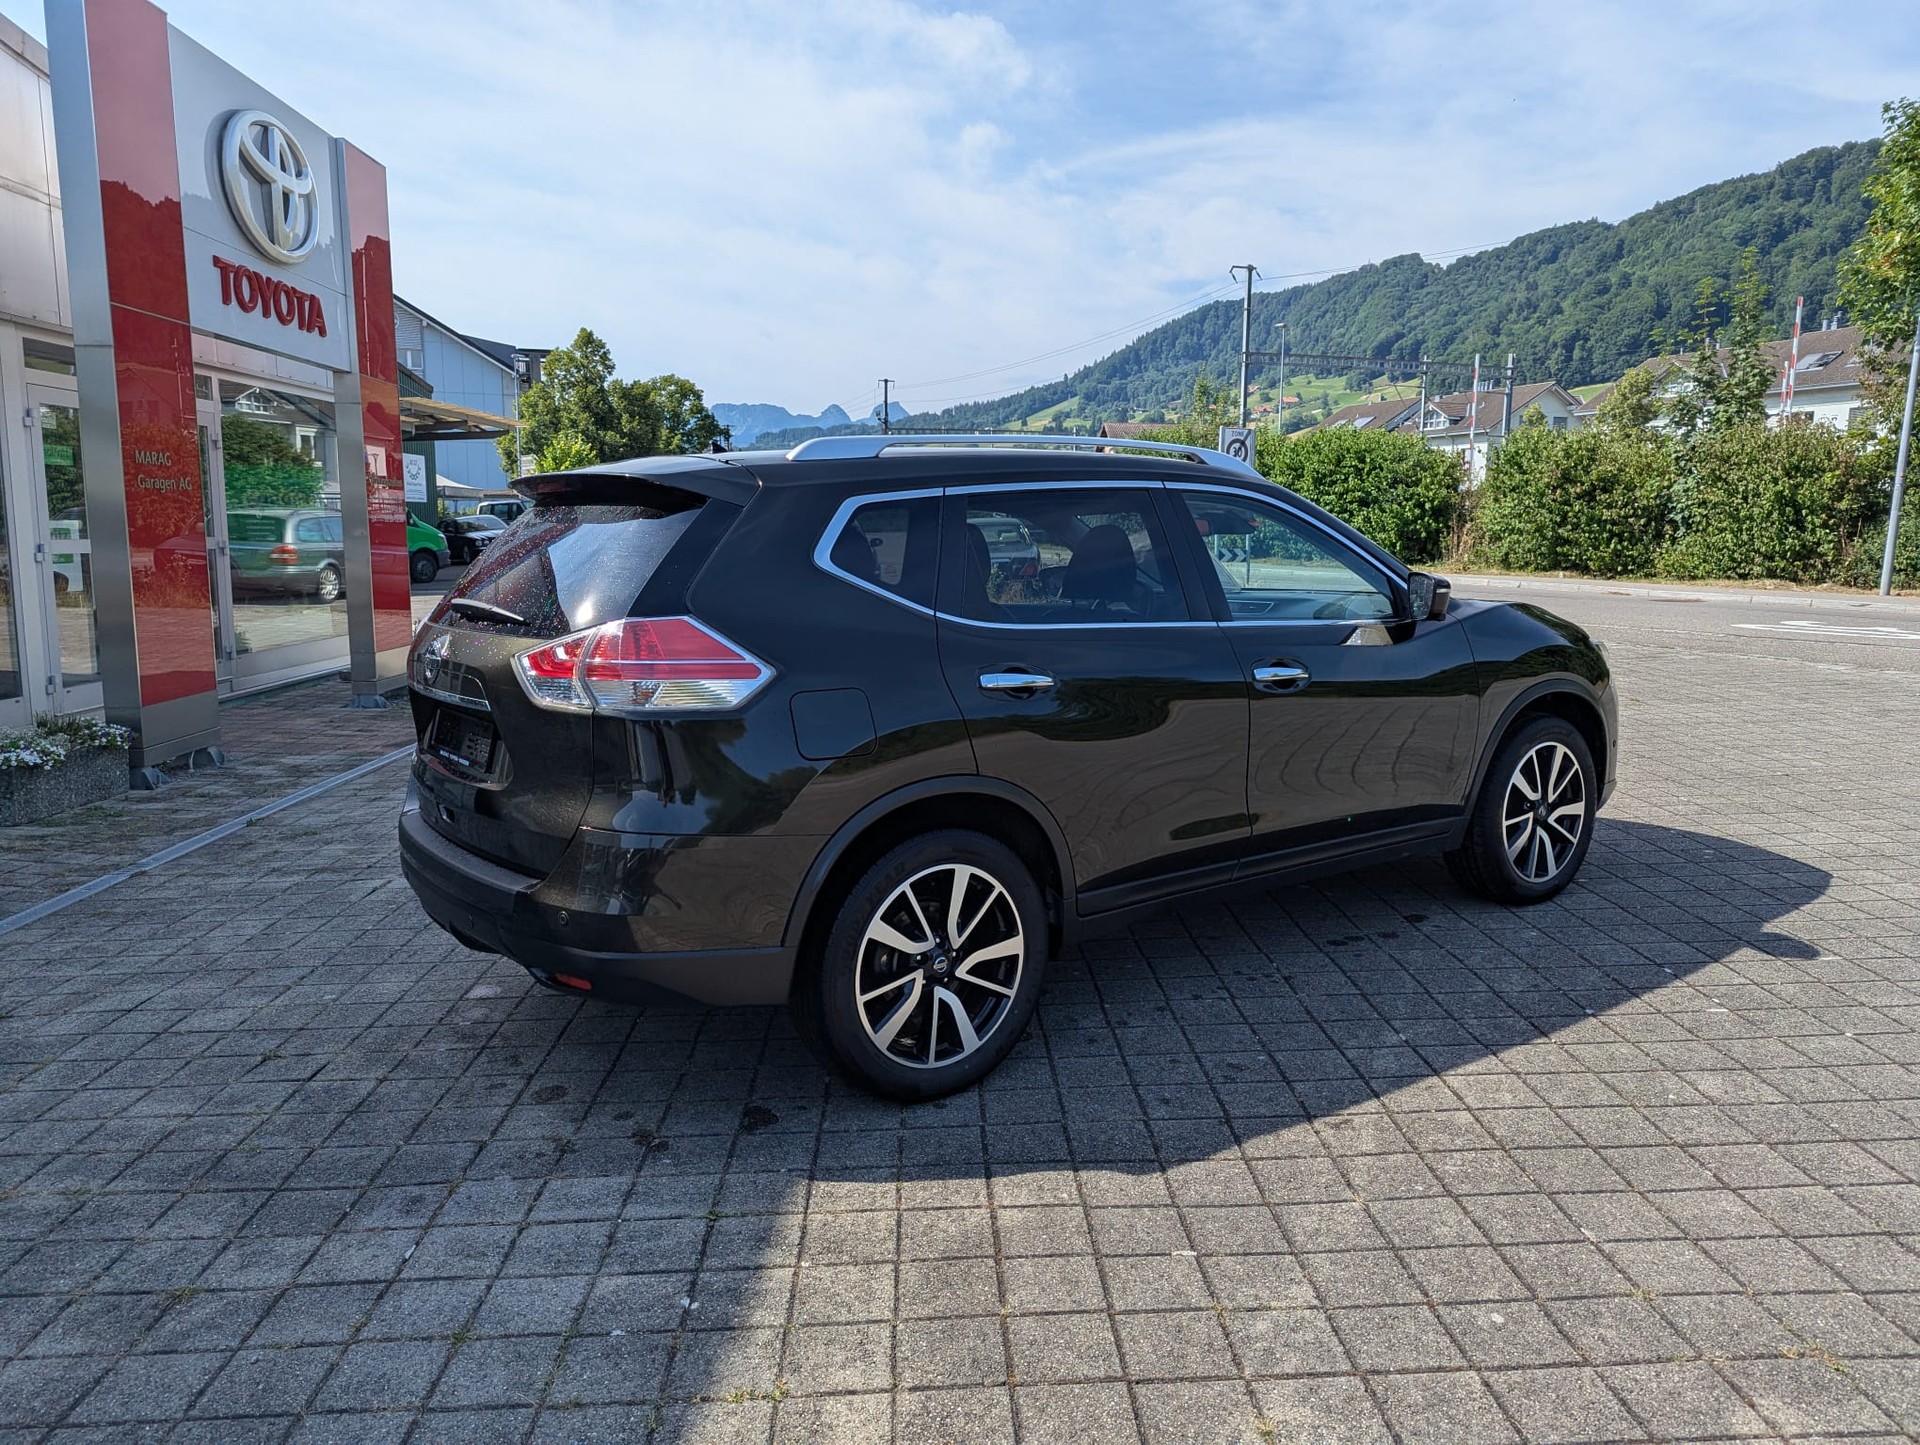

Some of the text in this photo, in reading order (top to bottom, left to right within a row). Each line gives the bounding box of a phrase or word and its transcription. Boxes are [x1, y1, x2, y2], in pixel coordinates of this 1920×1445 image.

[212, 254, 328, 338] TOYOTA
[135, 450, 172, 466] MARAG
[1232, 446, 1243, 458] 30
[137, 474, 193, 493] Garagen AG
